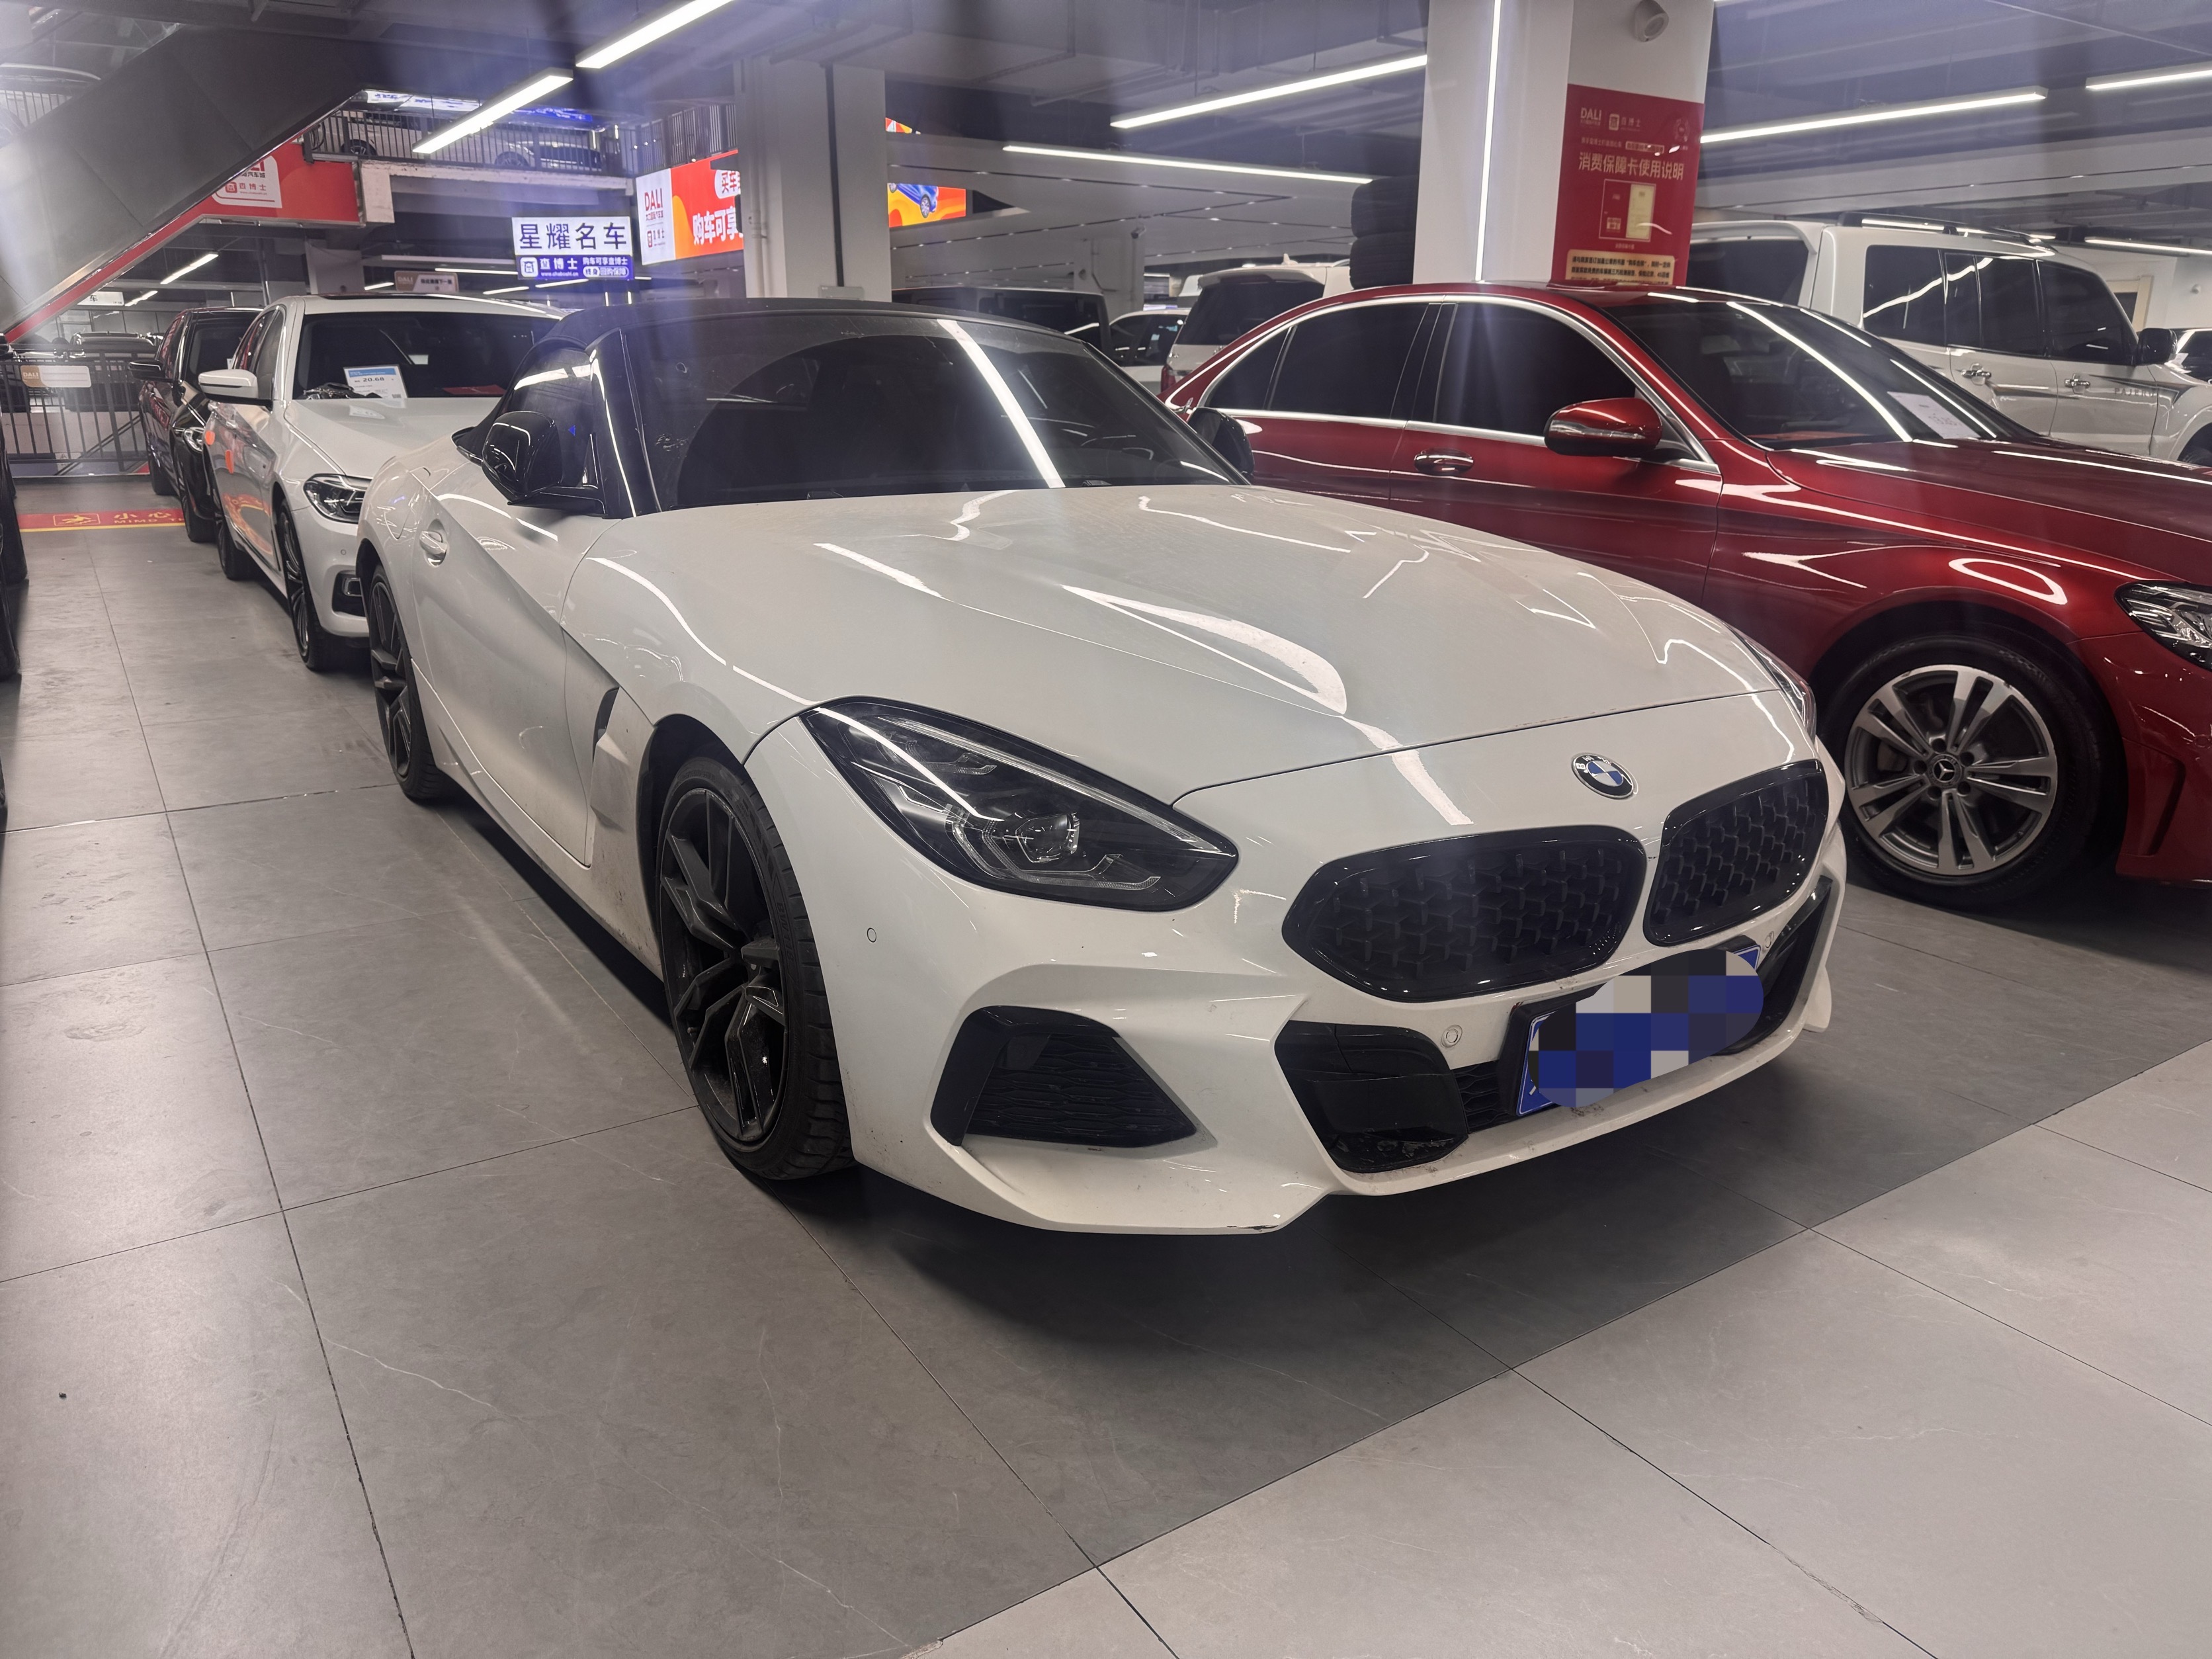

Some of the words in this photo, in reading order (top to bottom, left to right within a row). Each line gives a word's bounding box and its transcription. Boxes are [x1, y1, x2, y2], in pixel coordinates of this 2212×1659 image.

[1580, 107, 1601, 120] DALI
[1578, 151, 1684, 181] 消费保障卡使用说明
[721, 171, 741, 194] 买车
[644, 188, 663, 211] DALI
[519, 222, 626, 249] 星耀名车
[692, 205, 744, 247] 购车可享
[540, 257, 577, 270] 查博士
